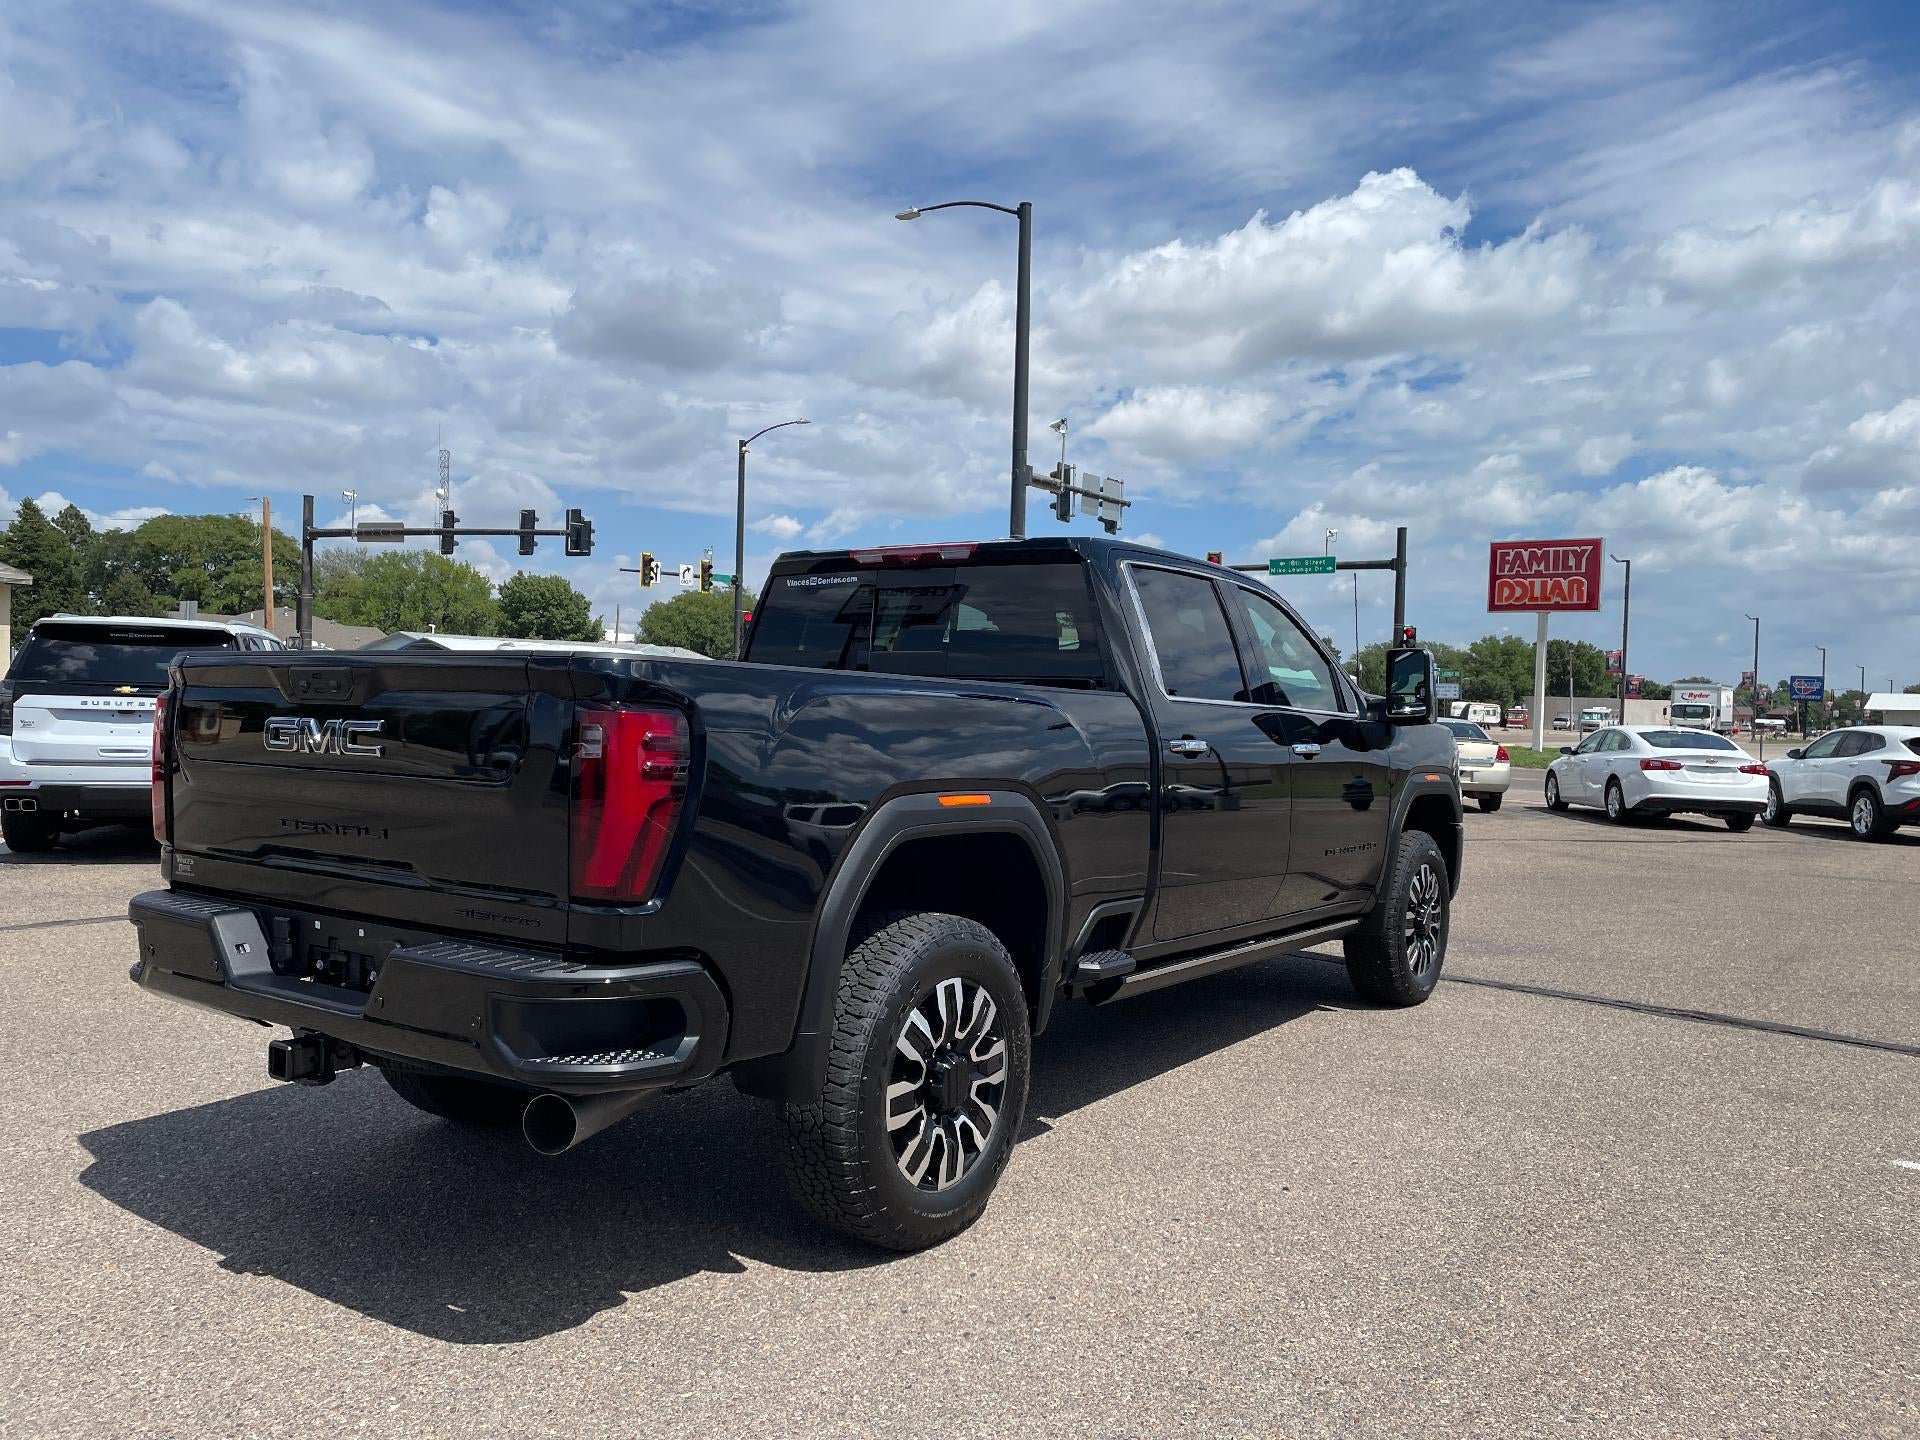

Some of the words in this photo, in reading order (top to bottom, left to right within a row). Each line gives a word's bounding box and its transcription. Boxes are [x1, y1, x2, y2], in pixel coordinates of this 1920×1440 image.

[1496, 546, 1594, 575] FAMILY
[1495, 576, 1588, 605] DOLLAR
[264, 716, 386, 758] GMC
[280, 818, 389, 840] DENALI
